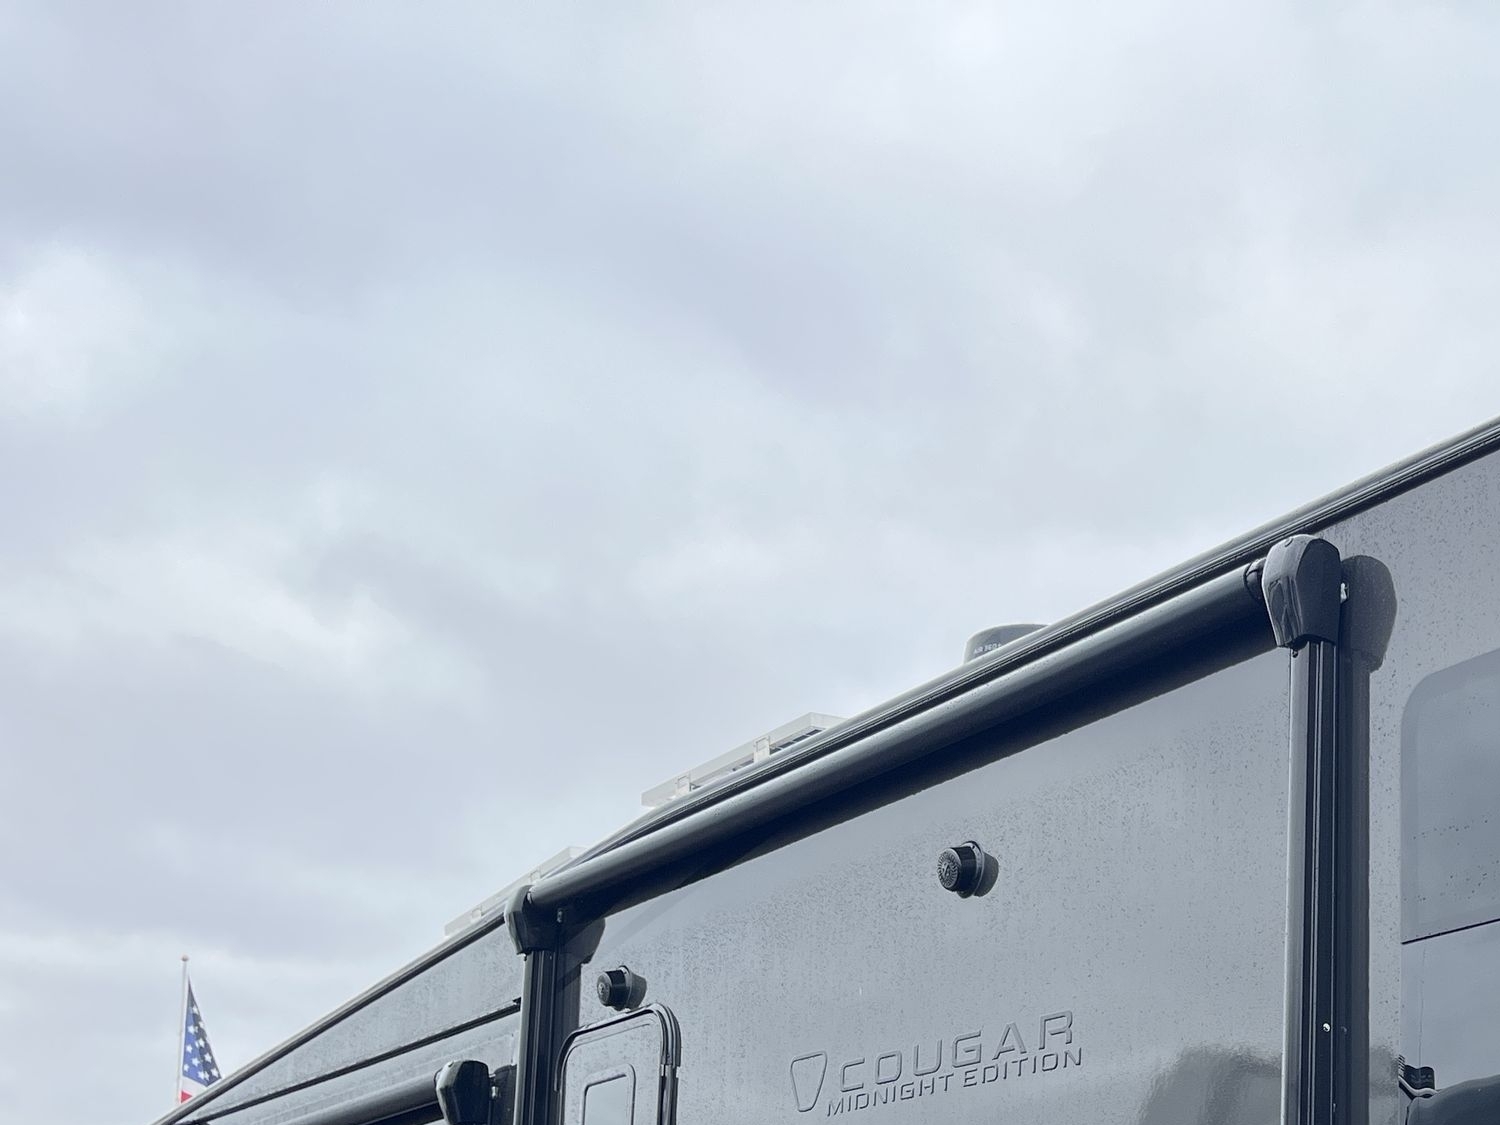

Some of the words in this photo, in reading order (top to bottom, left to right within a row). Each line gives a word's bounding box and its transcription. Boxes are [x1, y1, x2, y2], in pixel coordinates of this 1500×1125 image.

[826, 1073, 954, 1117] MIDNIGHT
[962, 1047, 1083, 1088] EDITION
[839, 1010, 1074, 1093] COUGAR
